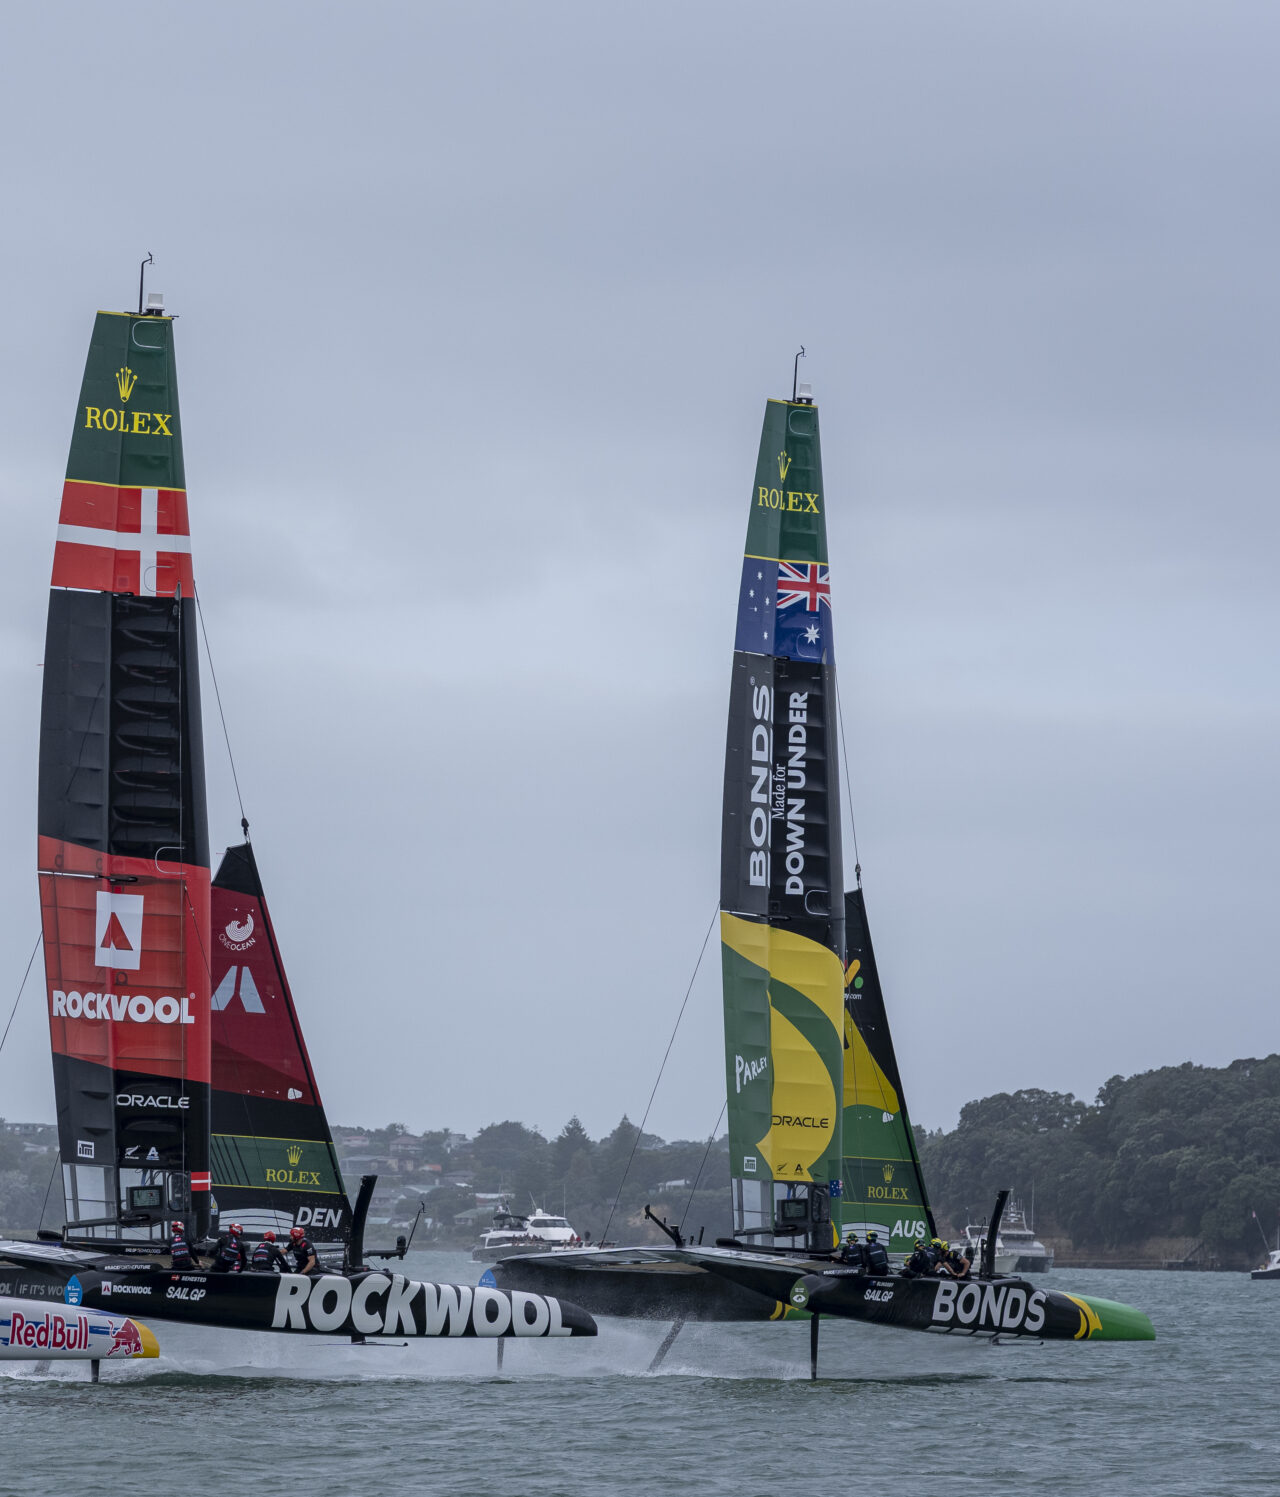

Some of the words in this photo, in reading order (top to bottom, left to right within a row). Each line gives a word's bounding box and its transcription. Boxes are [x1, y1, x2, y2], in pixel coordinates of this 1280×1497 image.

[84, 406, 173, 436] ROLEX
[757, 486, 820, 514] ROLEX
[788, 691, 808, 789] UNDER
[772, 763, 786, 783] for
[749, 685, 773, 887] BONDS
[771, 785, 785, 820] Made
[785, 798, 806, 895] DOWN
[116, 1094, 190, 1109] ORACLE
[771, 1115, 829, 1129] ORACLE
[266, 1168, 321, 1185] ROLEX
[867, 1186, 909, 1200] ROLEX
[295, 1206, 343, 1228] DEN
[891, 1219, 926, 1238] AUS
[19, 1284, 28, 1295] IF
[30, 1284, 45, 1296] IT'S
[48, 1284, 65, 1297] WO
[112, 1284, 152, 1295] ROCKWOOL
[271, 1273, 573, 1337] ROCKWOOL
[932, 1280, 1047, 1332] BONDS
